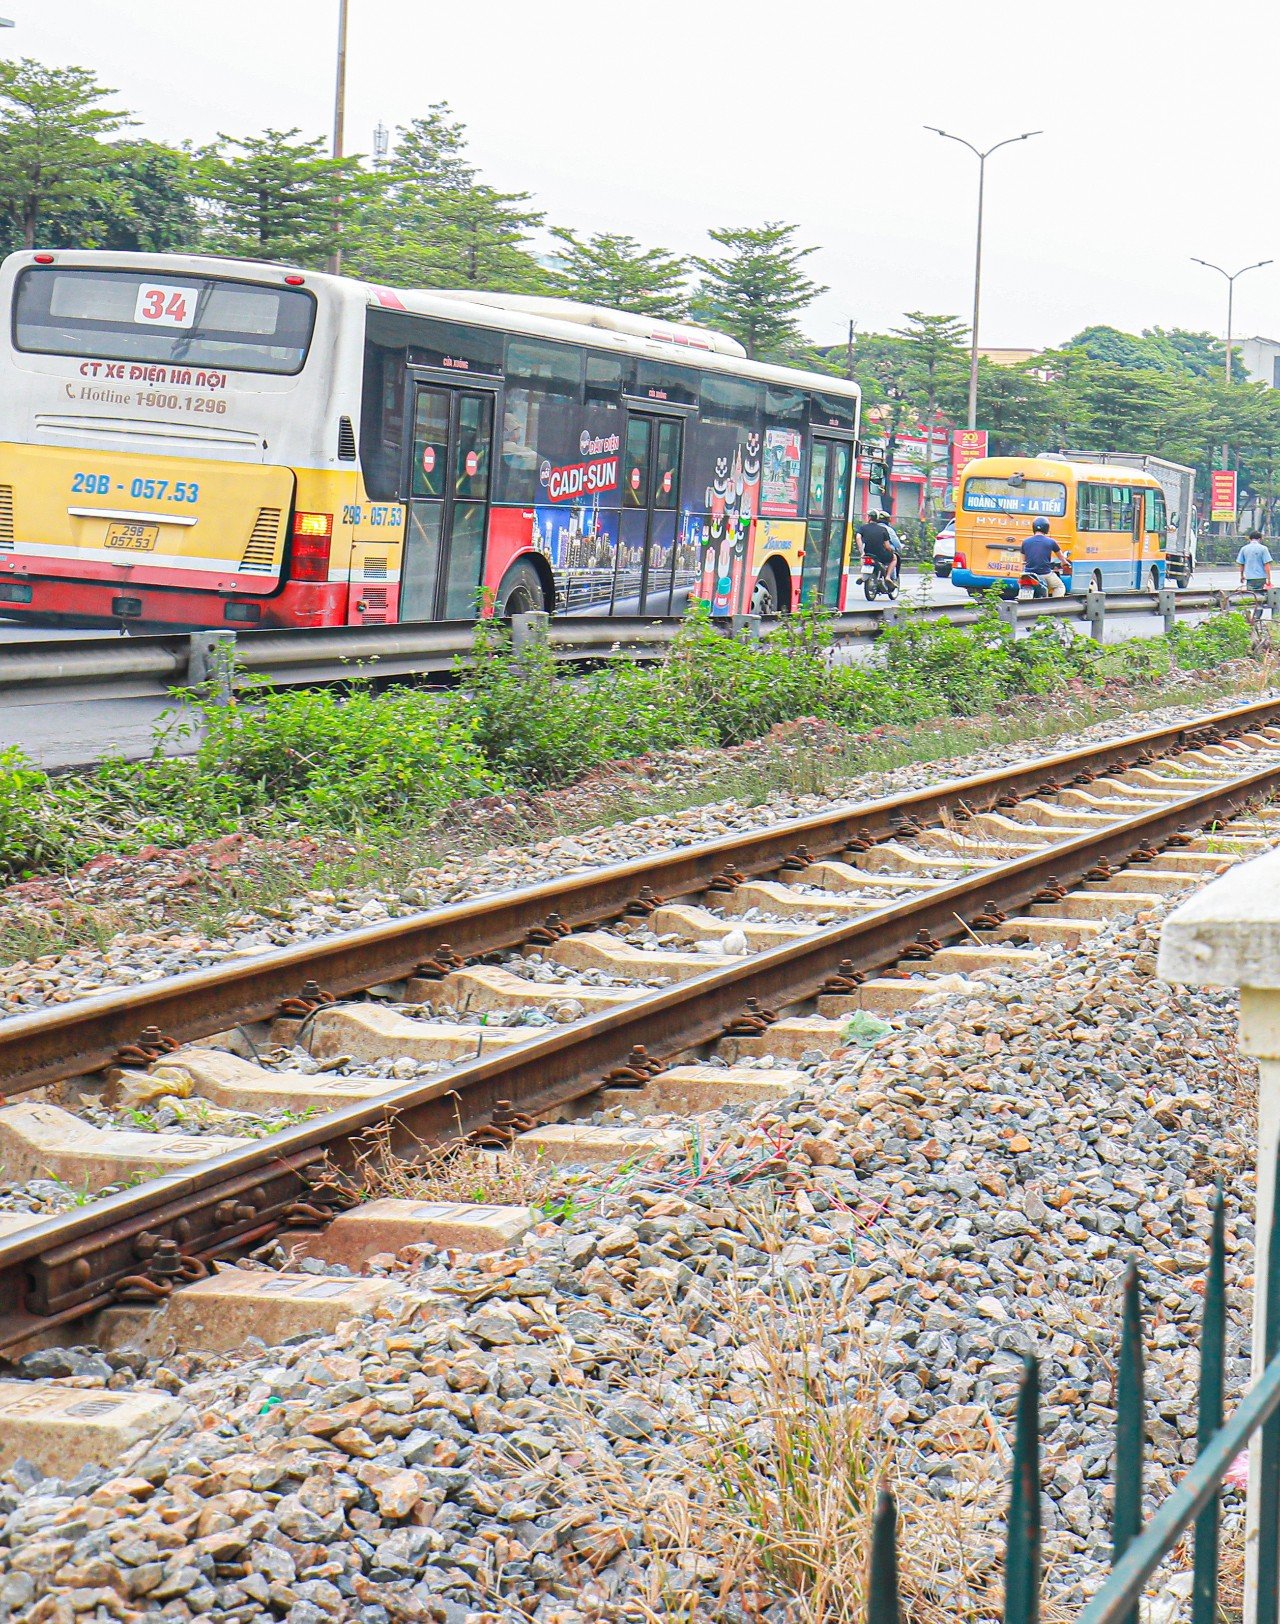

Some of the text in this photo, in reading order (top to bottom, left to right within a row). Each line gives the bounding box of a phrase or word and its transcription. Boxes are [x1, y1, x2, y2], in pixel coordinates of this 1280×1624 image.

[142, 290, 187, 322] 34
[79, 362, 102, 377] CT
[104, 363, 126, 379] XE
[170, 368, 192, 385] HÀ
[80, 387, 228, 414] Hotline 1900.1296
[71, 472, 110, 495] 29B
[130, 477, 200, 503] 057.53
[550, 461, 617, 498] CADI-SUN
[967, 494, 997, 509] HOÀNG
[998, 497, 1019, 510] VINH
[1028, 501, 1041, 512] LA
[1041, 498, 1062, 513] TIẾN
[342, 505, 361, 525] 29B
[370, 506, 402, 527] 057.53
[110, 536, 150, 549] 057.53
[121, 525, 145, 537] 29B
